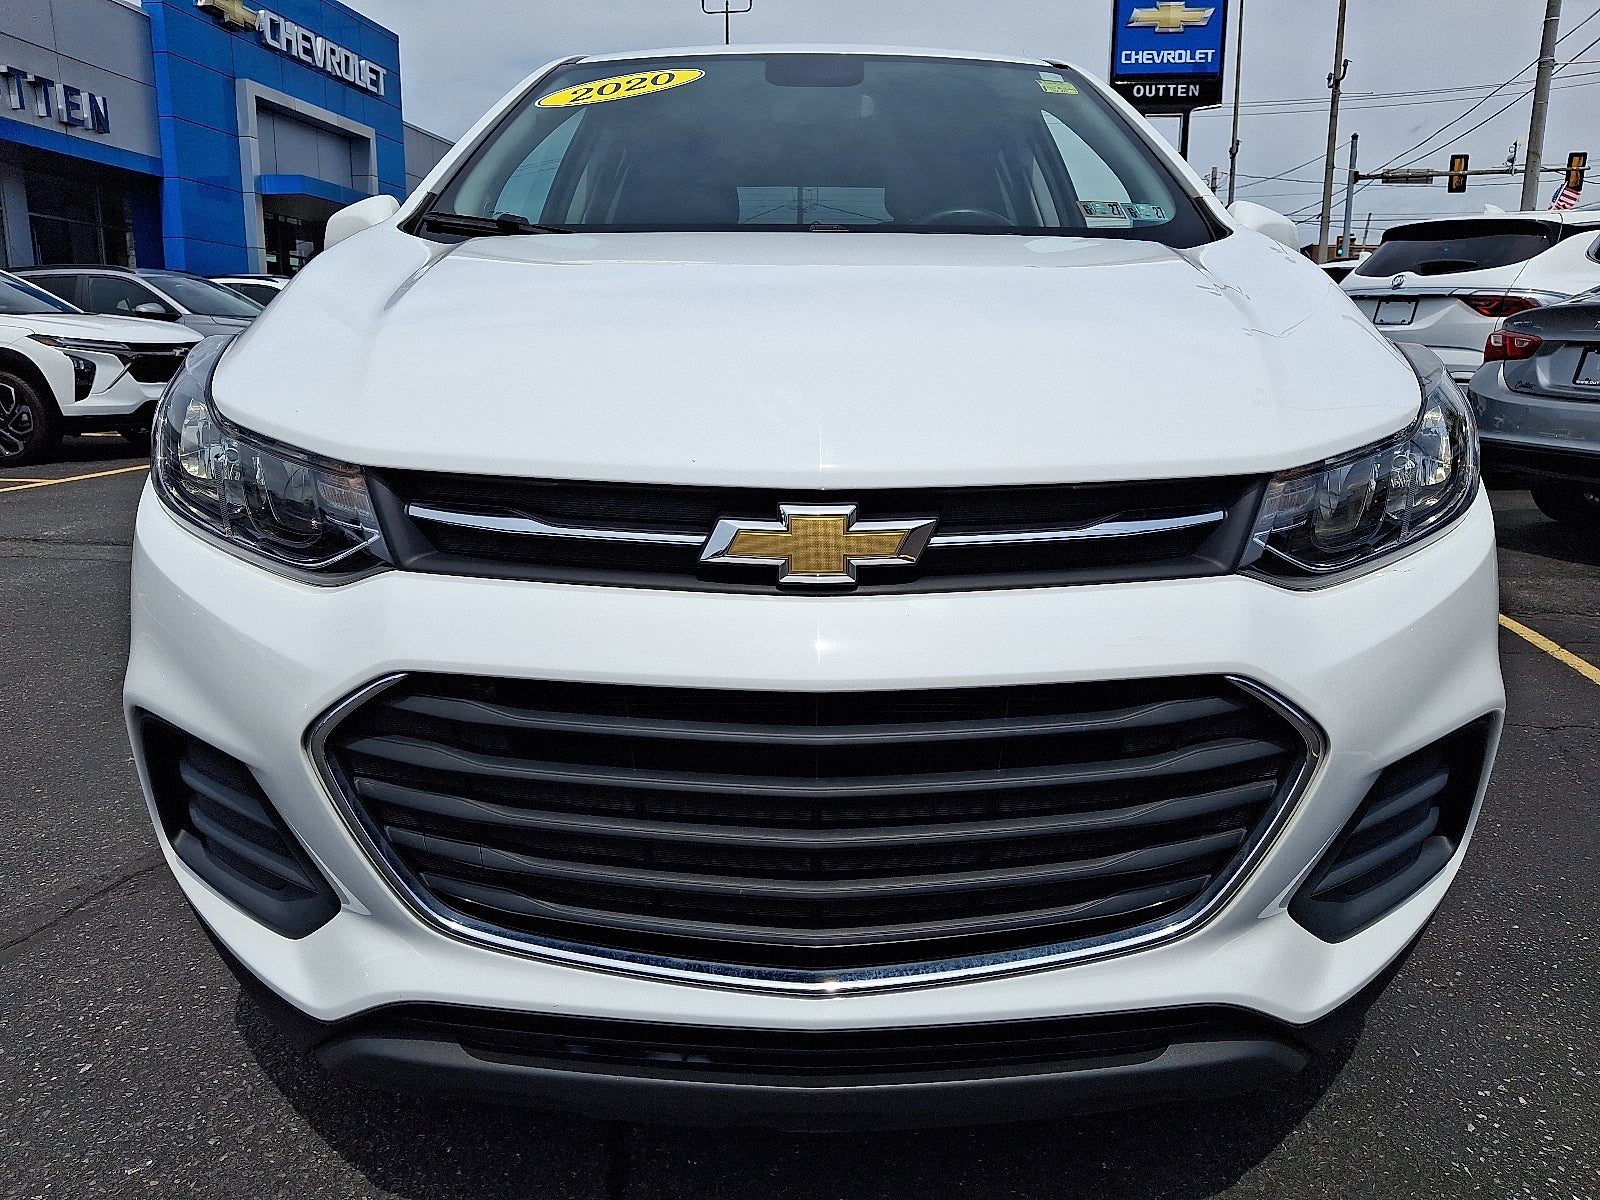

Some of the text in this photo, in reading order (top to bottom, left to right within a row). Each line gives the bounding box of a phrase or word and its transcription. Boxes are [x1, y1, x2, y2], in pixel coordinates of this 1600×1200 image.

[258, 9, 387, 96] CHEVROLET
[1121, 49, 1216, 64] CHEVROLET
[568, 72, 675, 104] 2020
[1132, 84, 1200, 97] OUTTEN
